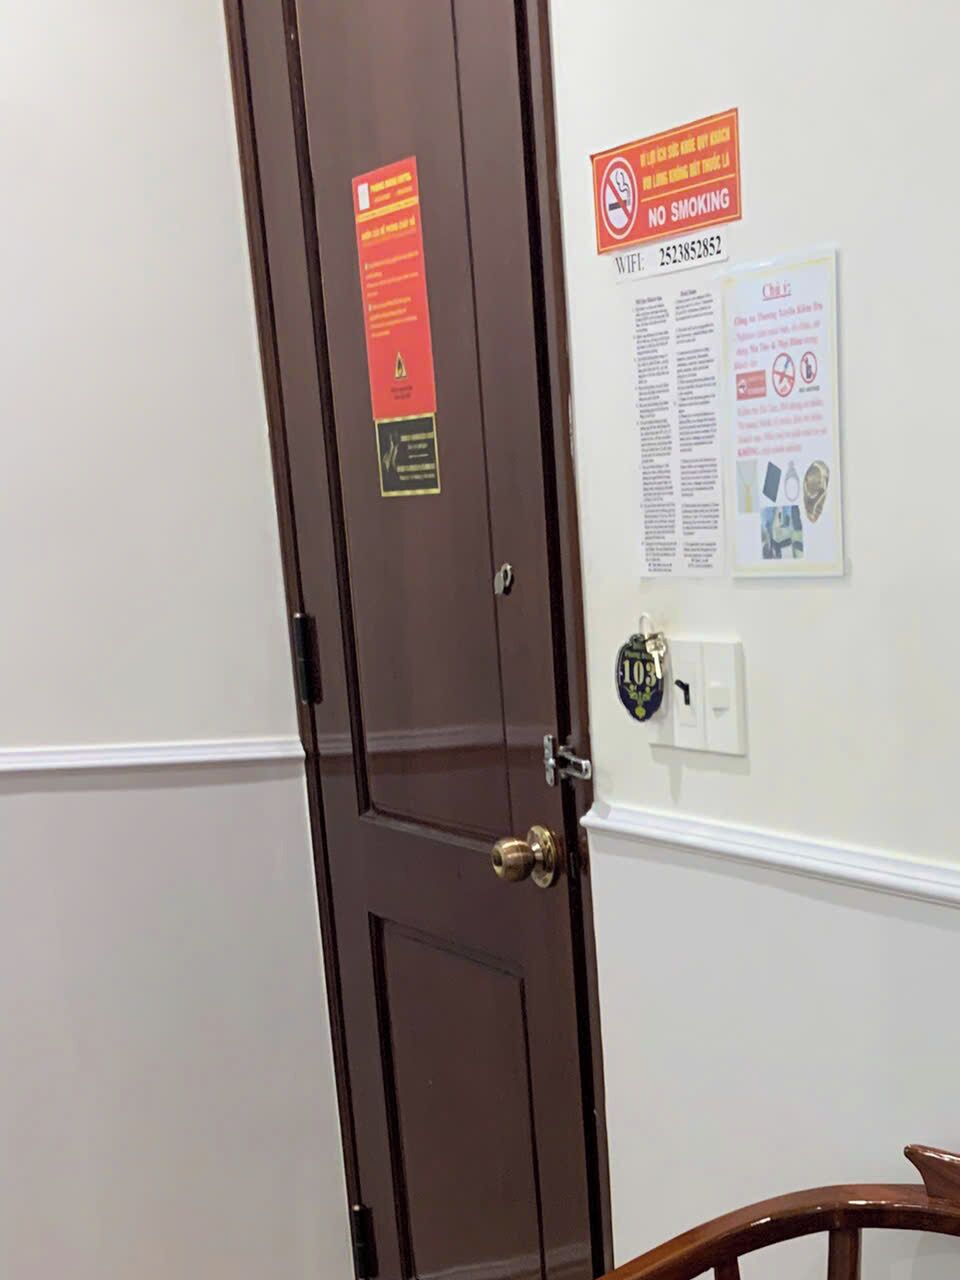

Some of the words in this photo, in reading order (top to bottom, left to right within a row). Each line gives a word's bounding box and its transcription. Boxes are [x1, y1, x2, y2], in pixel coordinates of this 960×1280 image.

[648, 205, 667, 228] NO
[671, 188, 730, 222] SMOKING
[615, 252, 645, 274] WIFI:
[659, 235, 722, 266] 2523852852
[623, 659, 656, 687] 103
